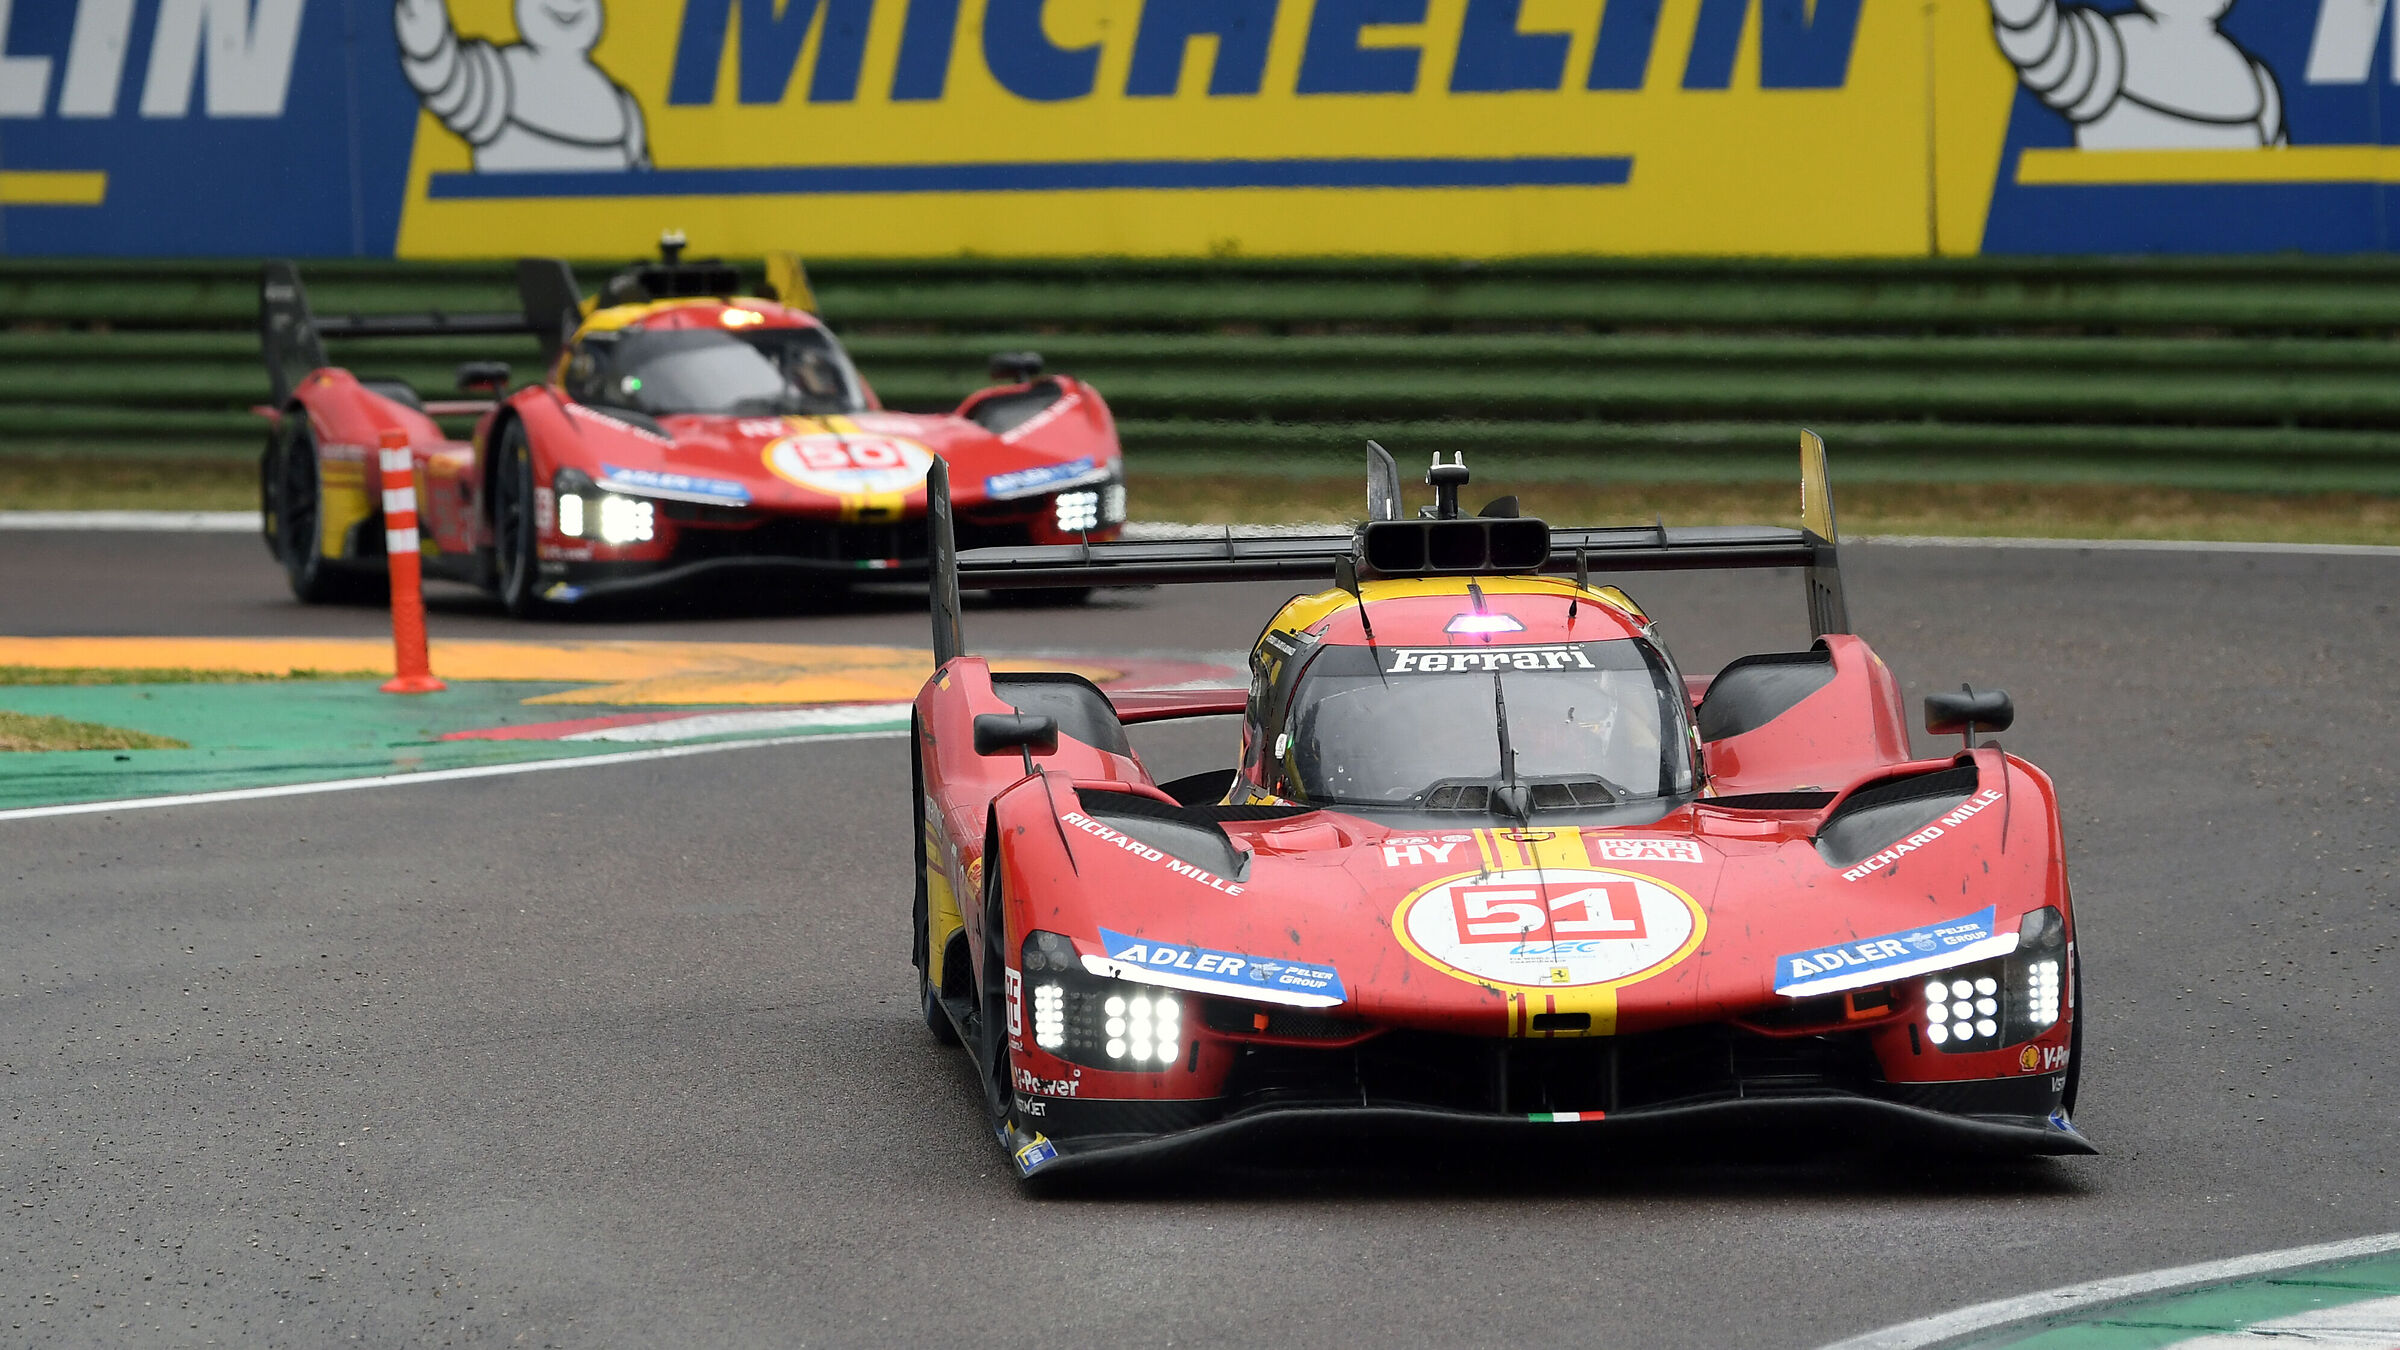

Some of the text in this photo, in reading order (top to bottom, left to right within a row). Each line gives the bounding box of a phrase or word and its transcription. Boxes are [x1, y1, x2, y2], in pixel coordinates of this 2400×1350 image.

[667, 0, 1861, 106] MICHELIN
[800, 440, 897, 468] 50
[1385, 643, 1596, 673] Ferrari
[1604, 840, 1692, 849] HYPER
[1841, 788, 2004, 882] RICHARD MILLE
[1061, 812, 1245, 897] RICHARD MILLE
[1383, 843, 1457, 867] HY
[1607, 847, 1695, 860] CAR
[1462, 887, 1637, 936] 51
[1509, 941, 1601, 955] WEC
[1789, 923, 1981, 978] ADLER PELZER
[1943, 931, 1988, 946] GROUP
[1112, 943, 1334, 981] ADLER PELZER
[1278, 975, 1328, 989] GROUP
